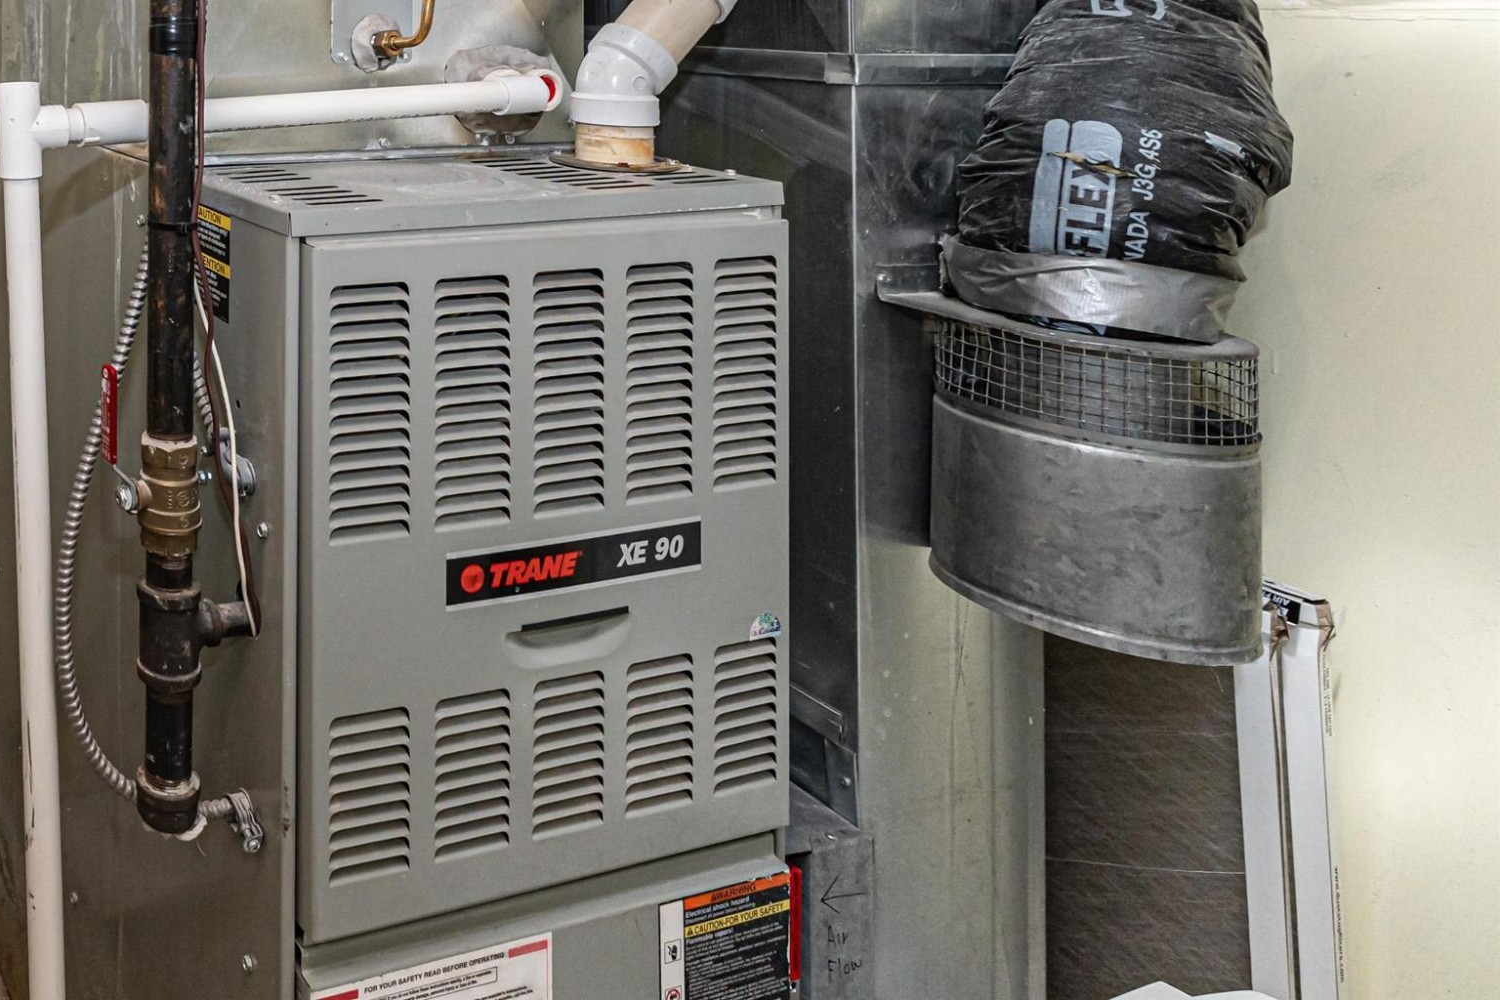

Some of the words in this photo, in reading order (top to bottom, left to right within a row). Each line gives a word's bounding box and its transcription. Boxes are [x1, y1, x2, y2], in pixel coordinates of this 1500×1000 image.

[199, 206, 222, 224] AUTION
[489, 550, 578, 589] TRANE
[617, 540, 649, 568] XE
[654, 534, 684, 561] 90
[716, 882, 756, 900] WARNING
[685, 906, 712, 918] Electrical
[740, 910, 758, 921] YOUR
[760, 903, 784, 917] SAFETY
[826, 925, 848, 946] Air
[363, 984, 378, 994] FOR
[379, 980, 397, 991] YOUR
[398, 973, 423, 987] SAFETY
[424, 968, 441, 978] READ
[442, 961, 467, 974] BEFORE
[468, 952, 505, 968] OPERATING
[827, 958, 863, 982] Flow
